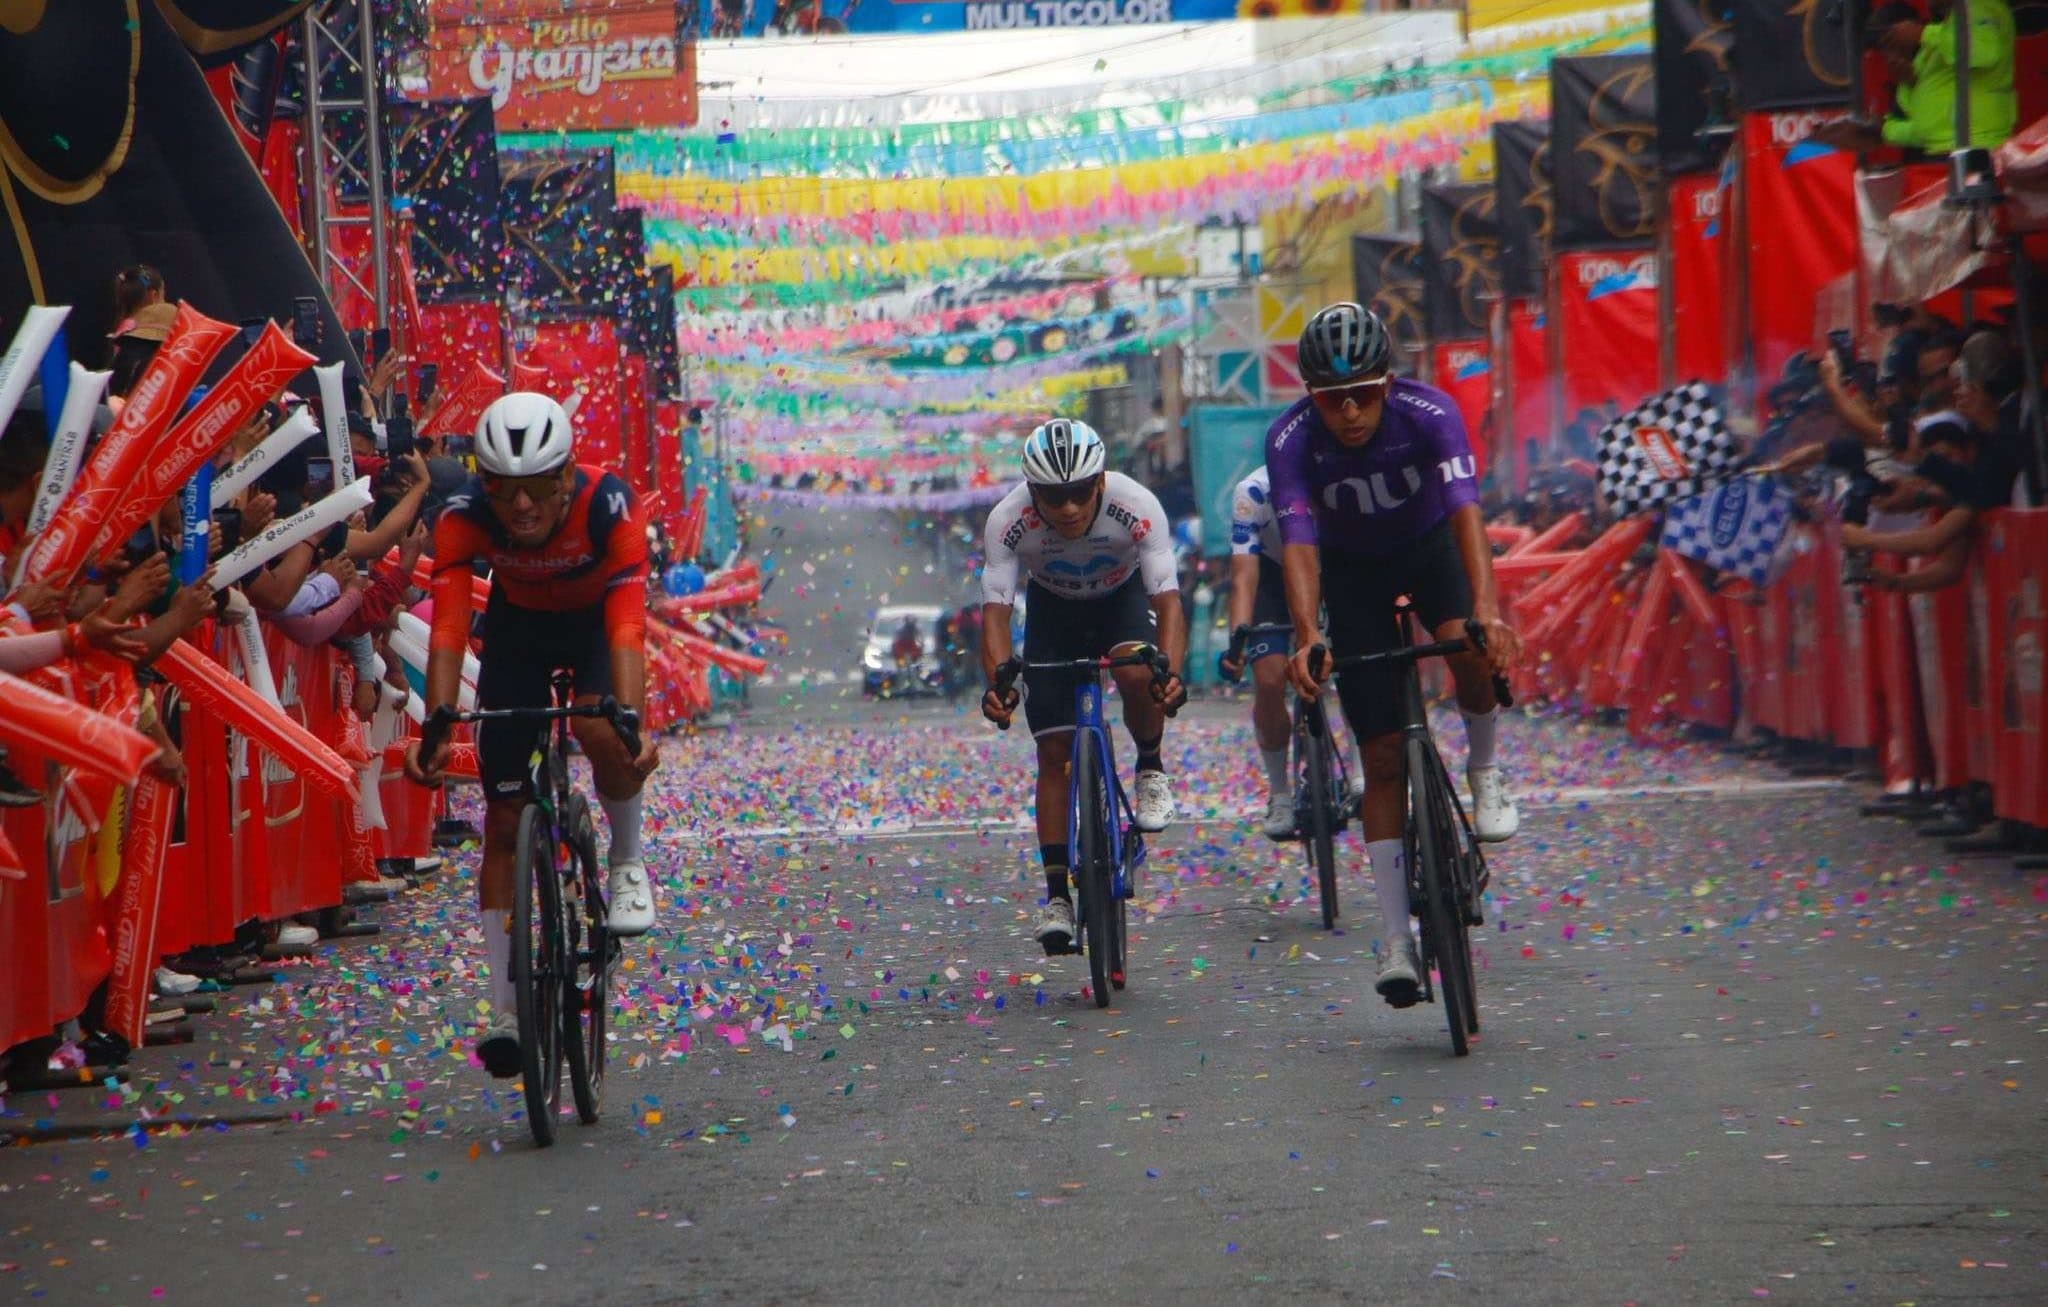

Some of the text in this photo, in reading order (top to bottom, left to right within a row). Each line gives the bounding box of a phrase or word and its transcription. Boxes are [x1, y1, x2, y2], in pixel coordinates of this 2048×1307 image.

[533, 16, 609, 46] Pollo
[966, 0, 1170, 31] MULTICOLOR
[1395, 391, 1446, 418] SCOTT
[1273, 406, 1312, 451] SCOTT
[1106, 502, 1139, 533] BEST
[1003, 518, 1028, 552] BEST
